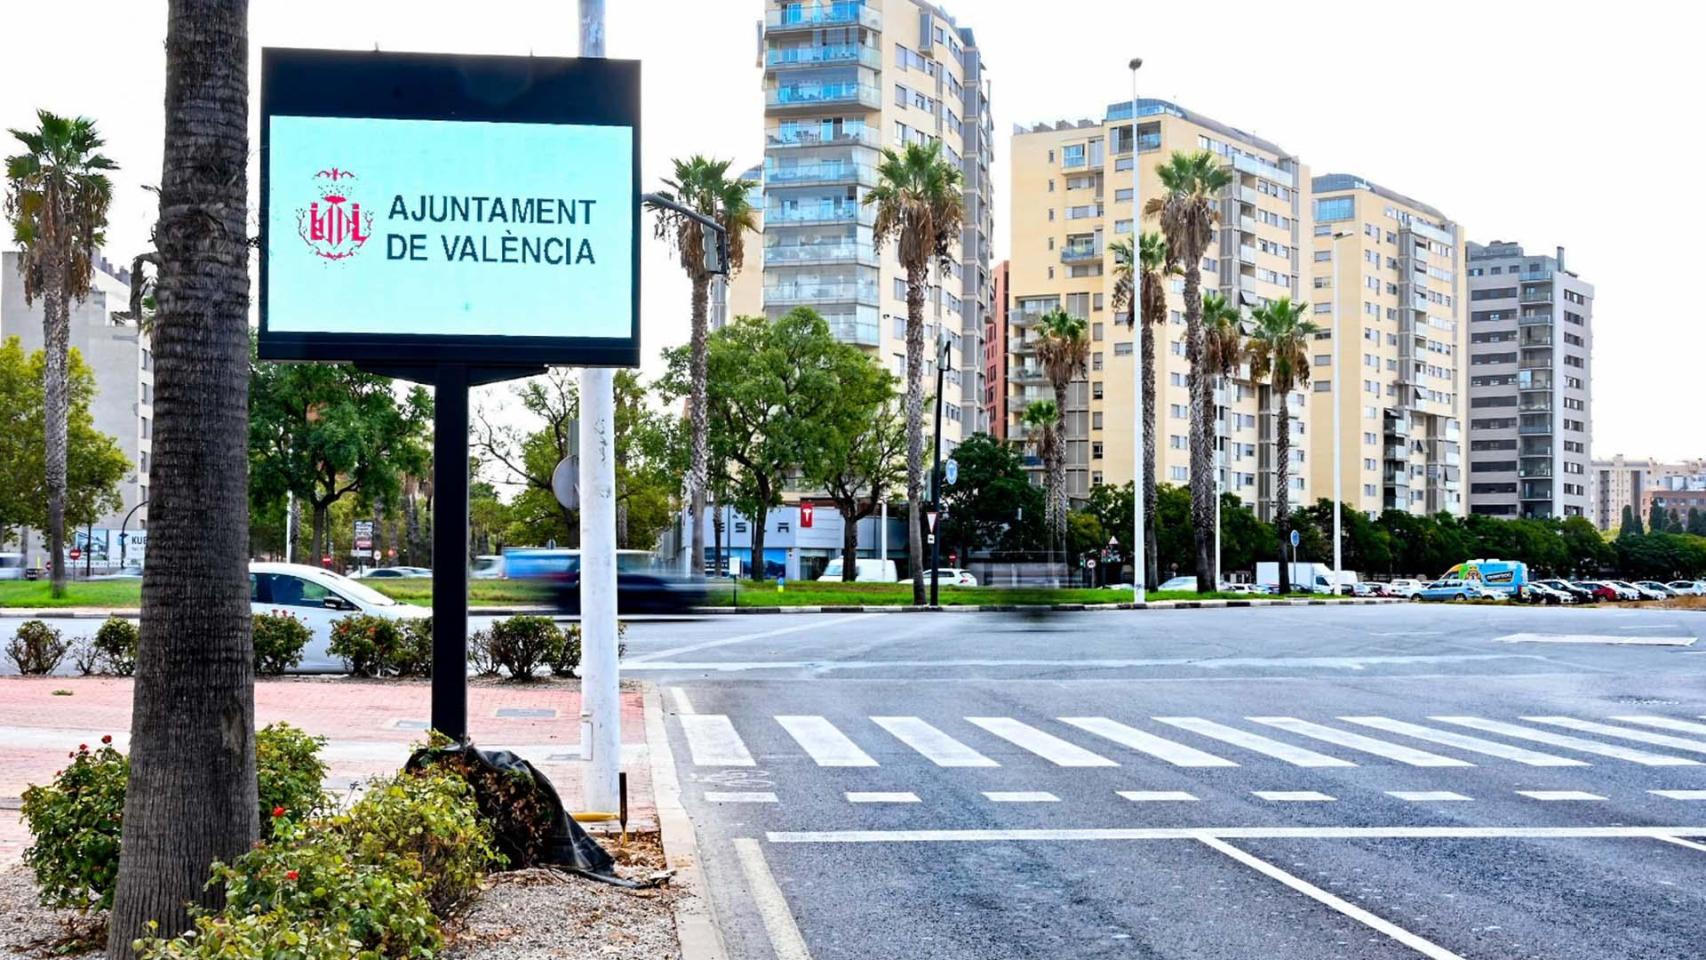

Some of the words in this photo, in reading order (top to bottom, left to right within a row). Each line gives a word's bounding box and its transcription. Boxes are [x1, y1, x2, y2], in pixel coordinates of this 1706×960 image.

[388, 194, 597, 225] AJUNTAMENT
[386, 233, 429, 261] DE
[440, 229, 596, 265] VALÈNCIA
